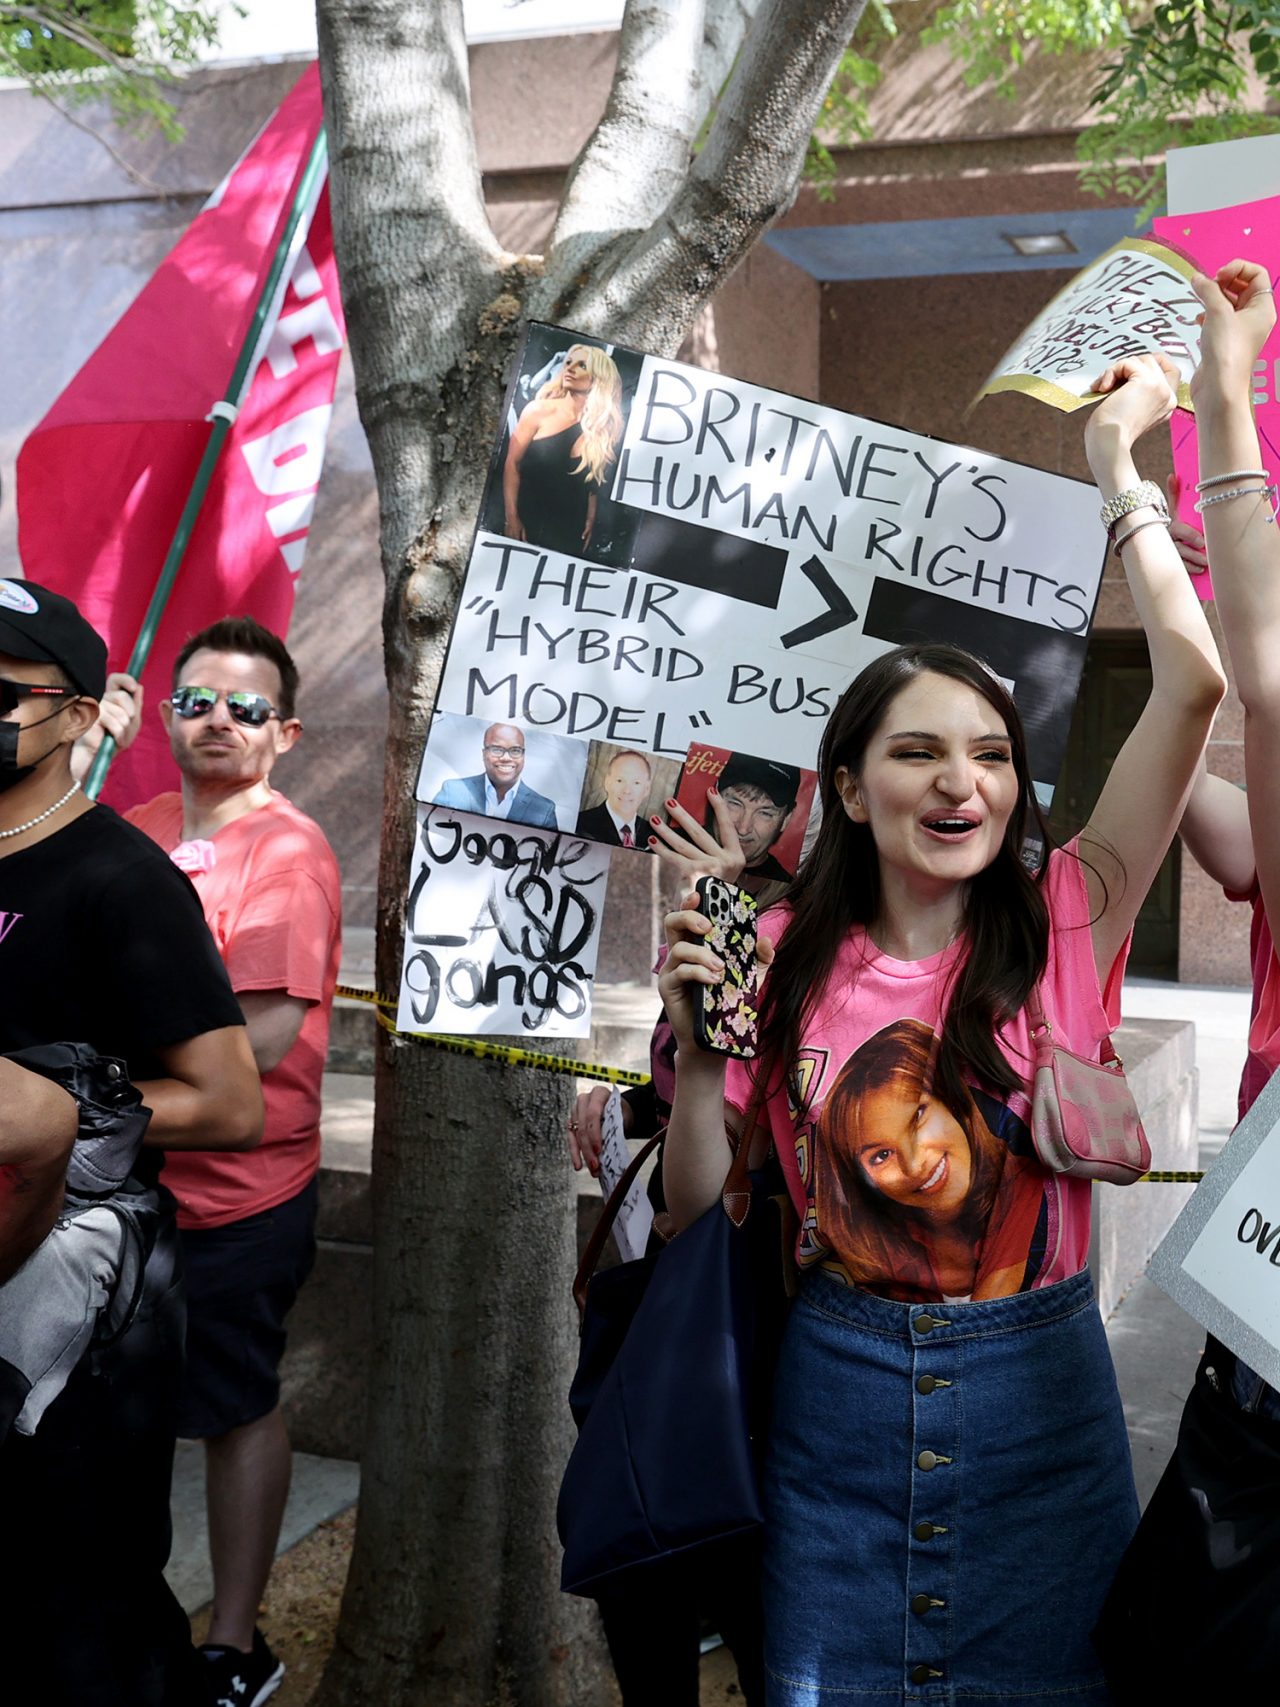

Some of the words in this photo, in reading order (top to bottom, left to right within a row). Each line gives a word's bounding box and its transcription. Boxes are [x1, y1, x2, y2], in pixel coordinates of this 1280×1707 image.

[640, 369, 1008, 544] BRITNEY'S
[481, 539, 686, 637] THEIR
[615, 448, 838, 553] HUMAN
[865, 522, 1090, 634] RIGHTS
[421, 804, 604, 898] Google
[407, 861, 597, 965] LASD
[405, 949, 594, 1030] gangs
